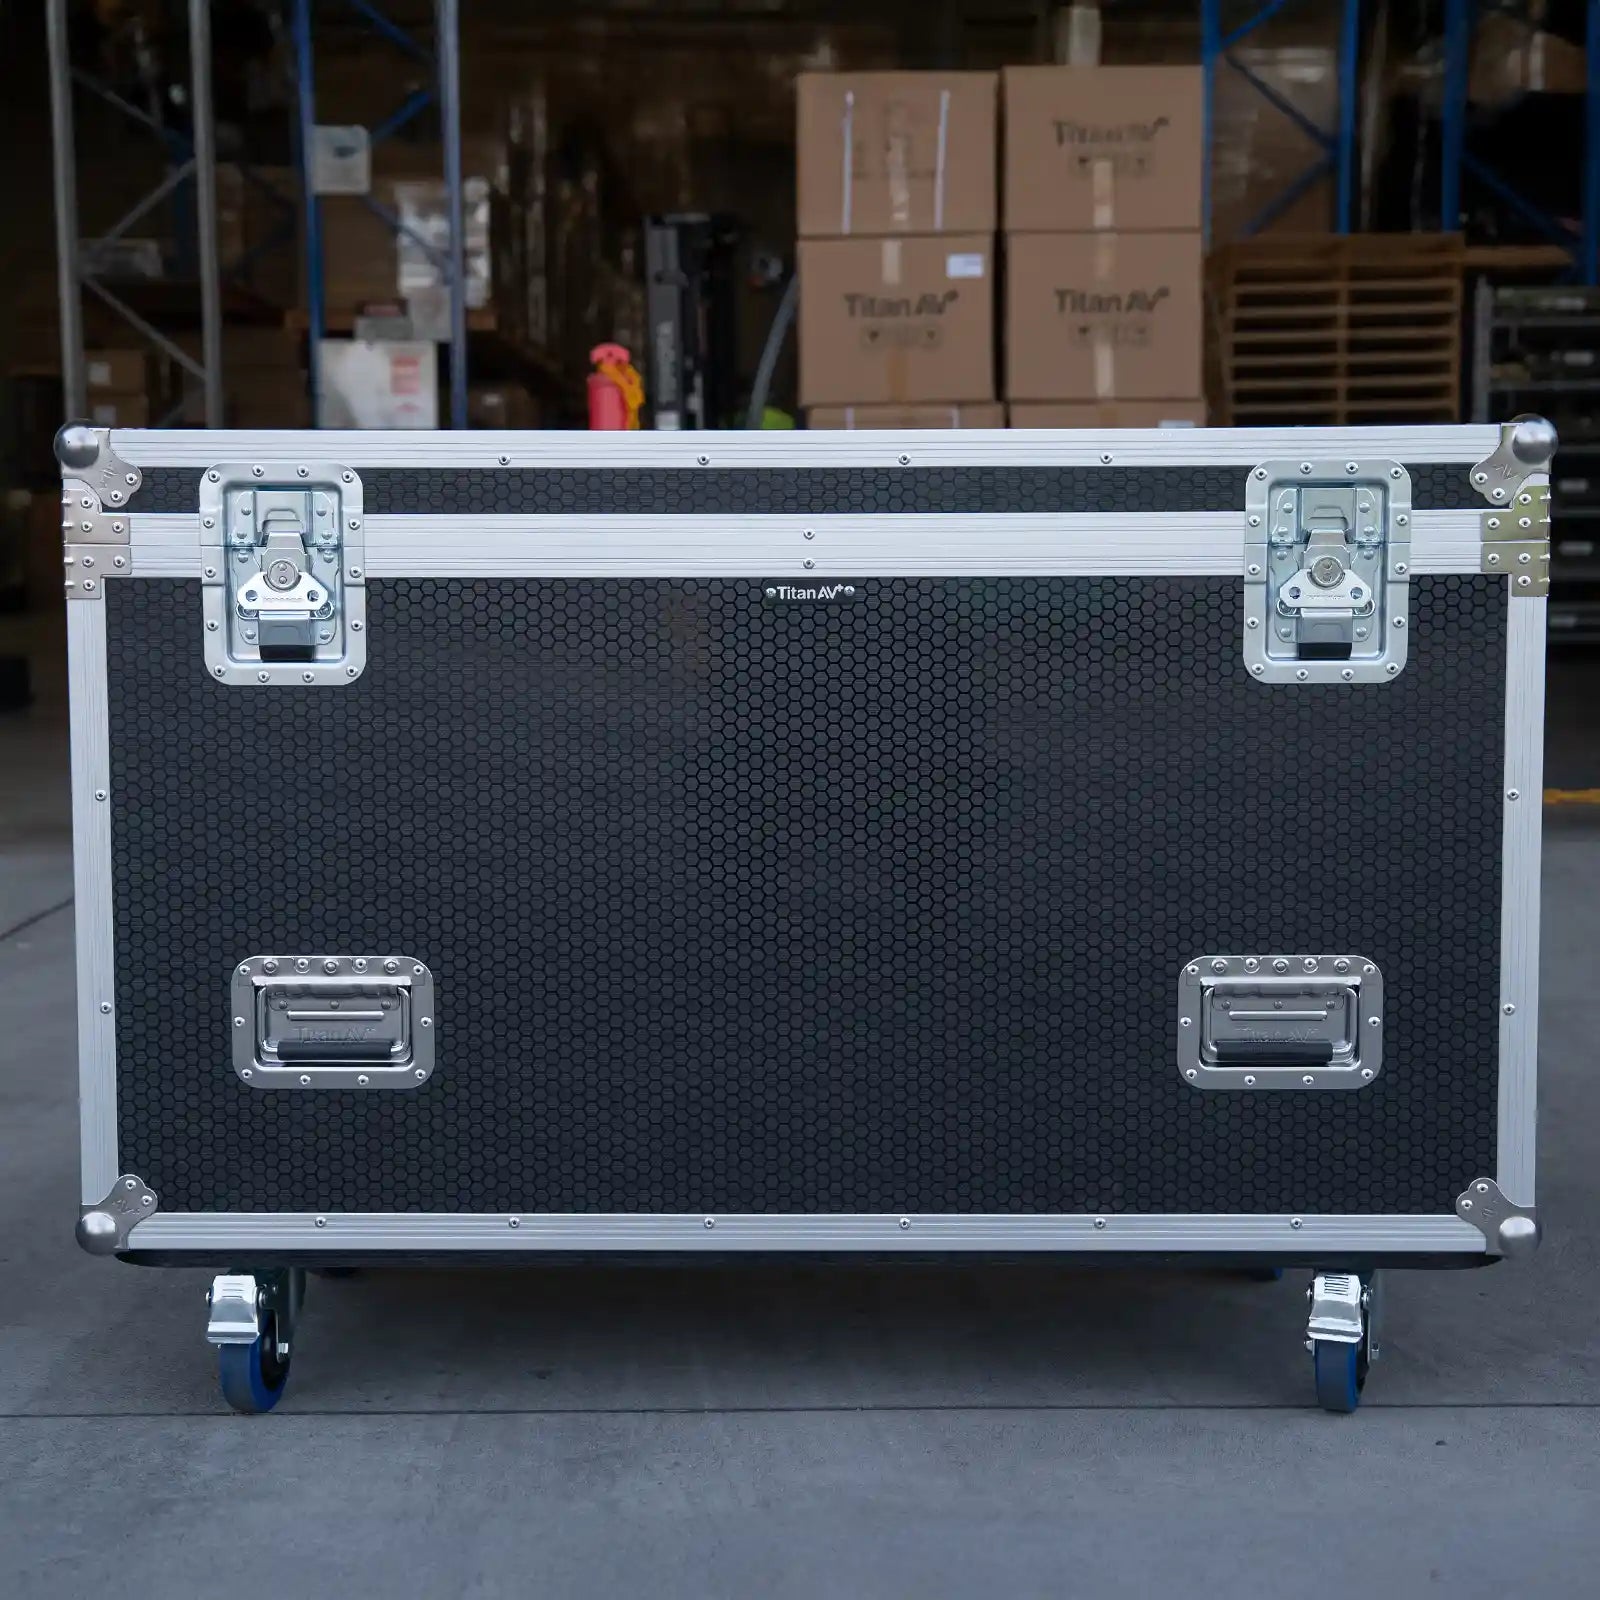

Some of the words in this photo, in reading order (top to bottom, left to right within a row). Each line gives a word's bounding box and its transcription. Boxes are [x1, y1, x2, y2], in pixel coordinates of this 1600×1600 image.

[842, 293, 912, 317] Titan
[1054, 287, 1122, 313] Titan
[776, 585, 816, 600] Titan
